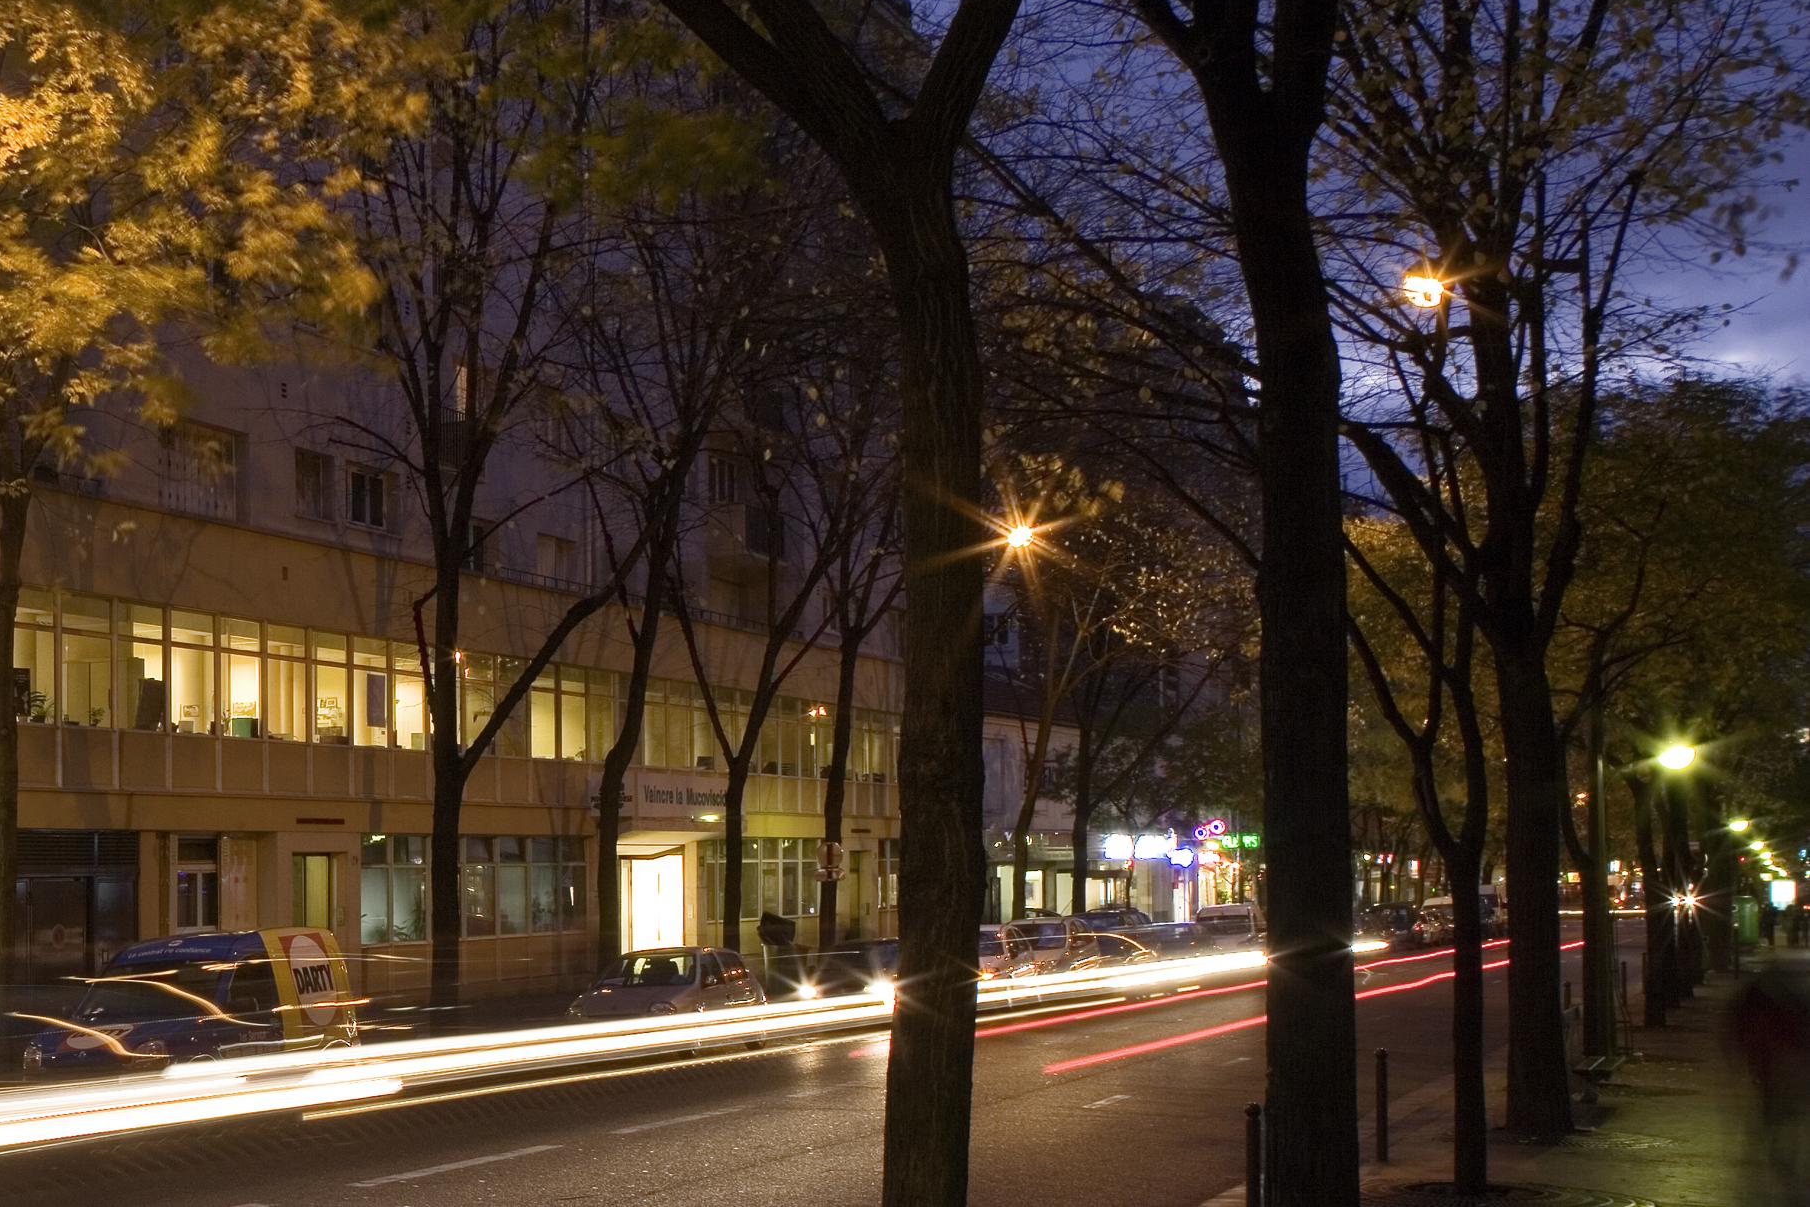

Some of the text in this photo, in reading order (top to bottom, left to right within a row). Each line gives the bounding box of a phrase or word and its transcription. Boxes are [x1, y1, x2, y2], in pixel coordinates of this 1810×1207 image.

[644, 785, 673, 805] Vaincre
[676, 787, 684, 805] la
[686, 788, 727, 807] Mucoviscid
[292, 964, 334, 995] DARTY
